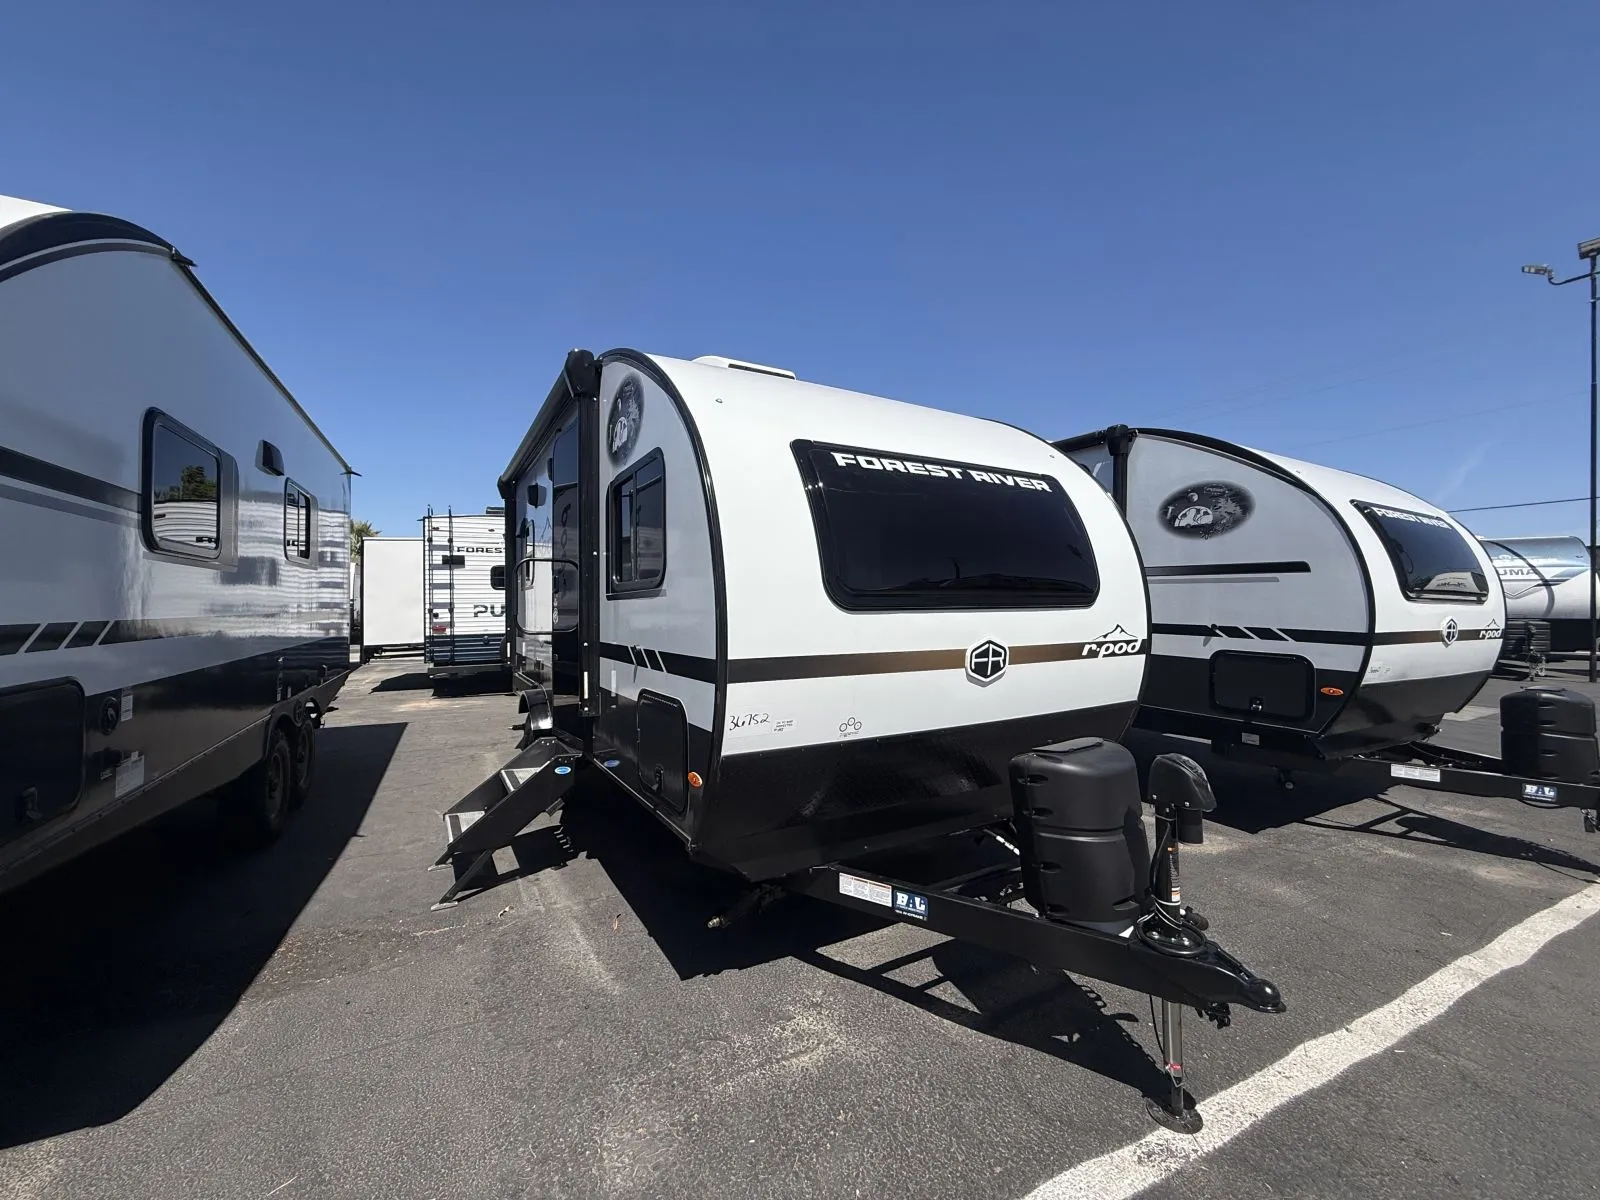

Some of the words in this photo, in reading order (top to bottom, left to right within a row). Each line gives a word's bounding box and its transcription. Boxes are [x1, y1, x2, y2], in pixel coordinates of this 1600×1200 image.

[831, 452, 963, 479] FOREST
[967, 469, 1053, 493] RIVER
[456, 546, 506, 554] FORES
